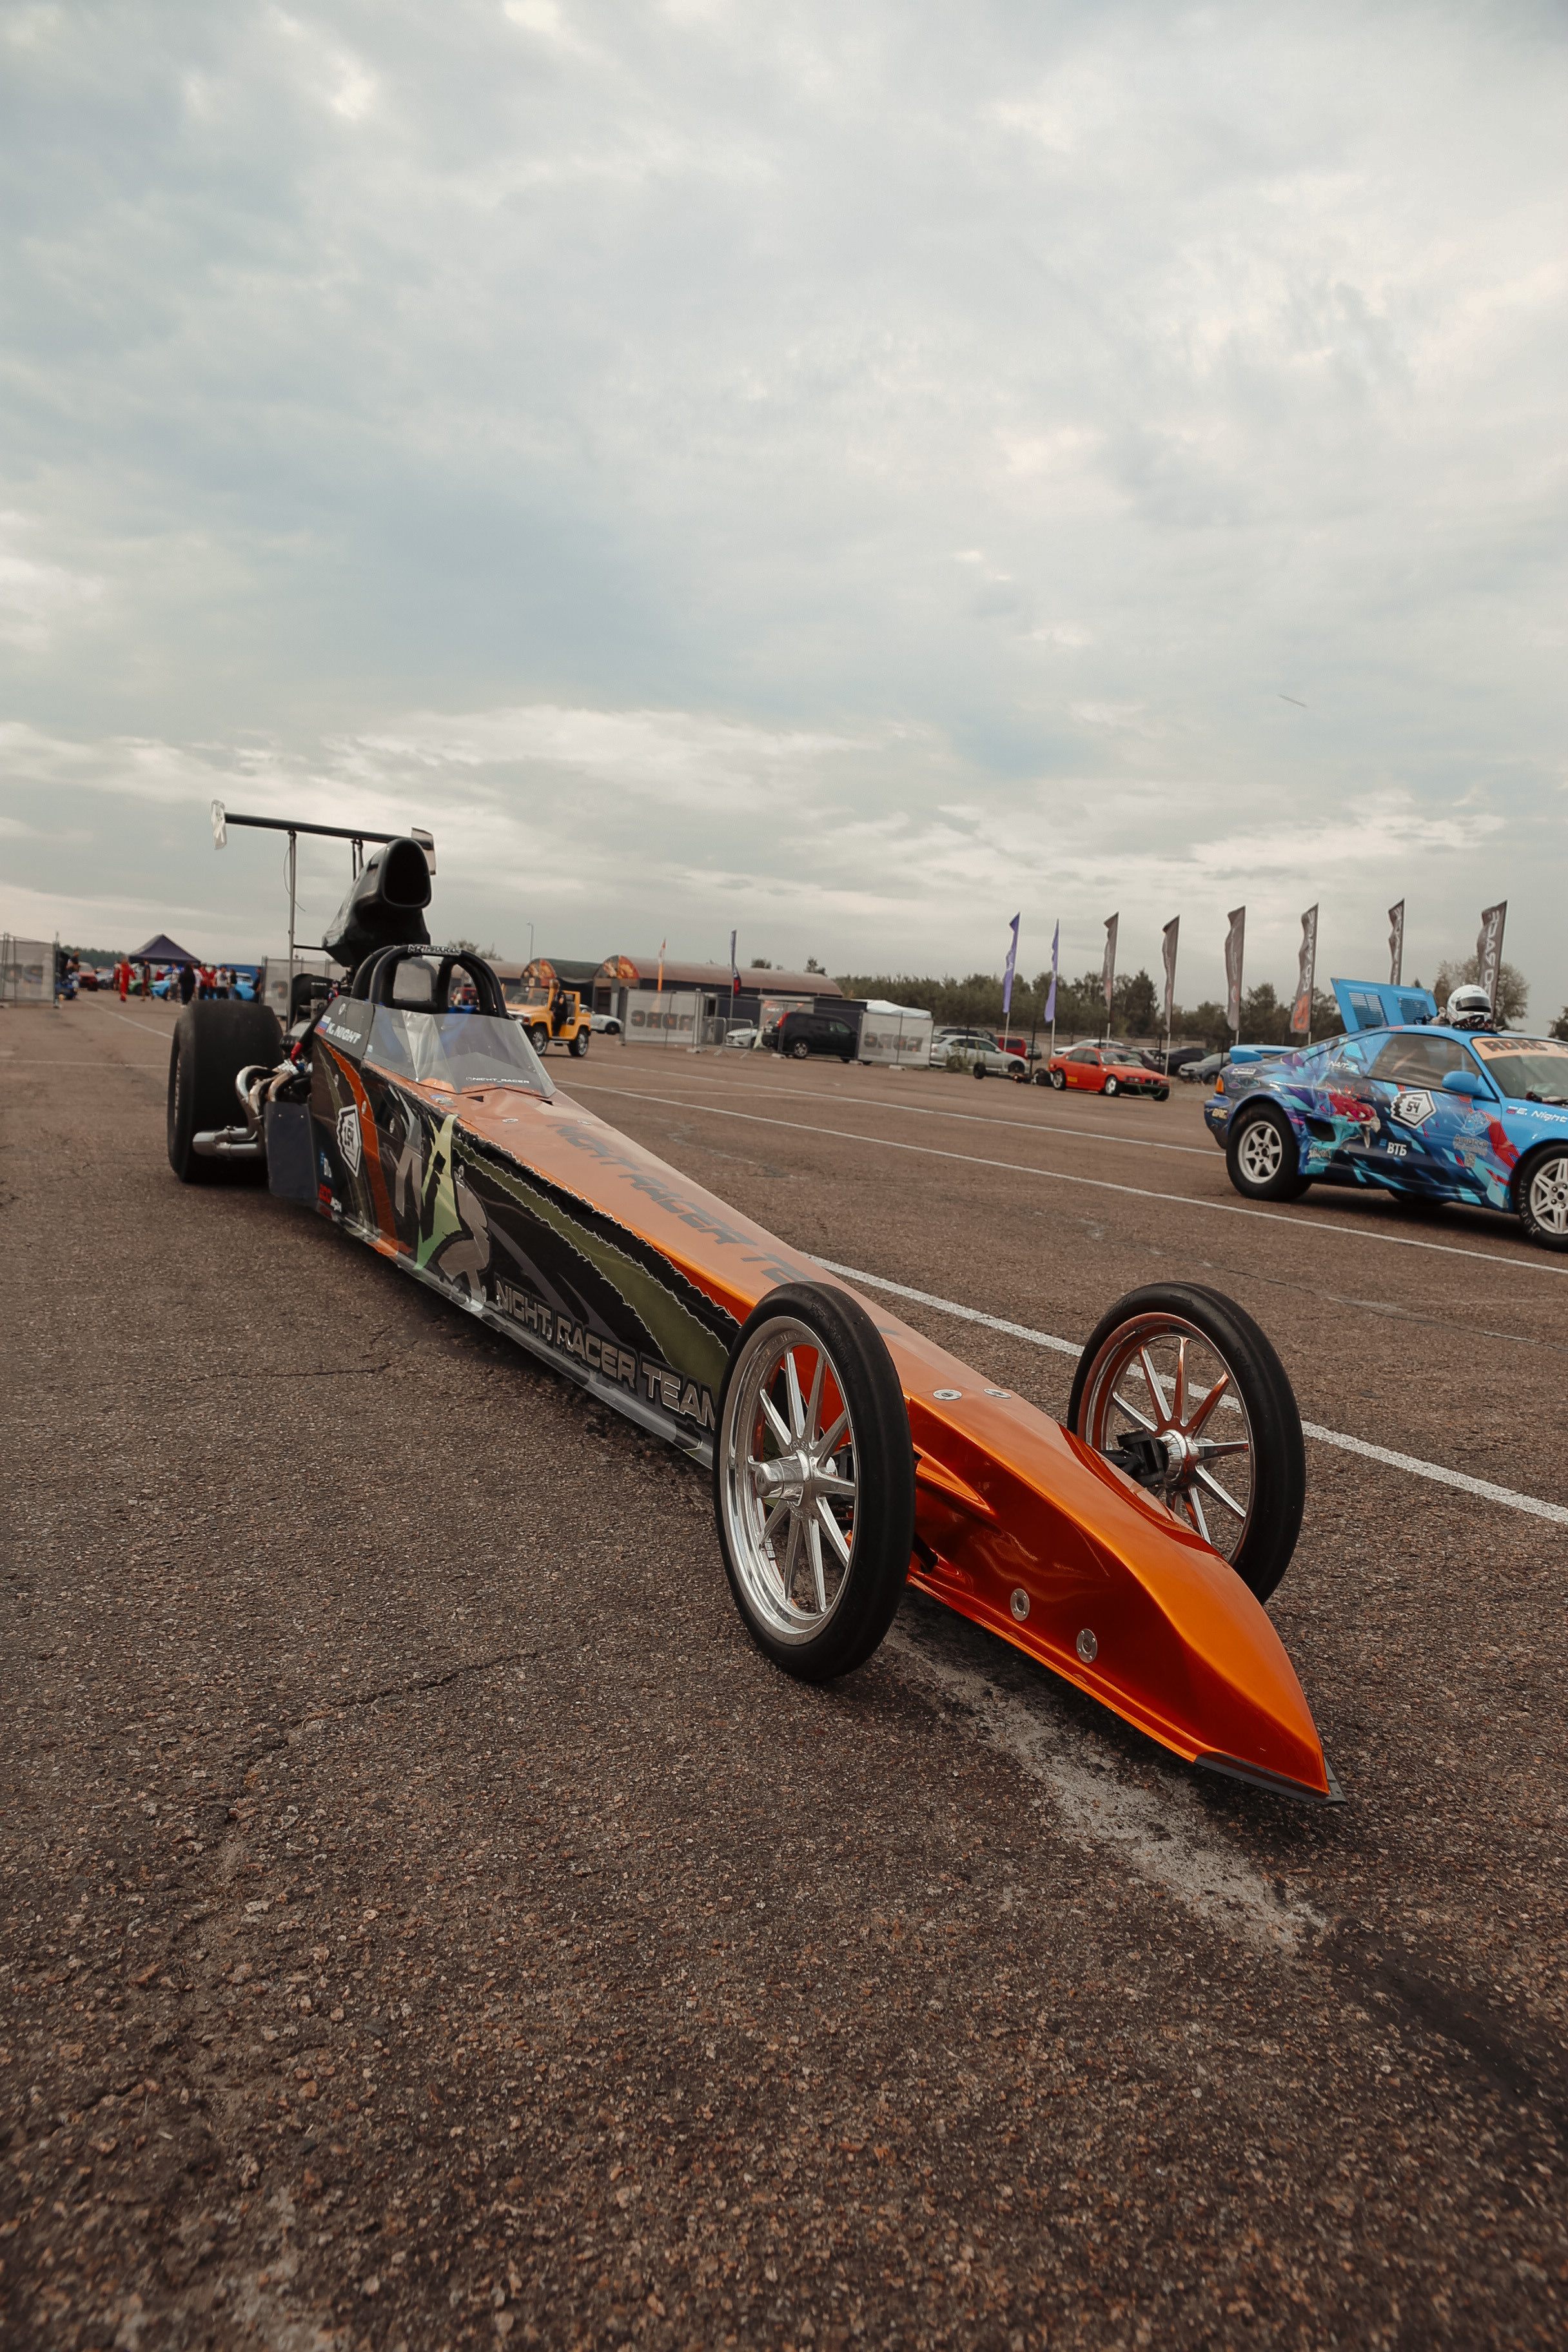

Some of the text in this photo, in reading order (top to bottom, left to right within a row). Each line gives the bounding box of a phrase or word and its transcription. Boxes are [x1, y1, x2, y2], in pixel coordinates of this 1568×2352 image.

[334, 1026, 362, 1044] NIGHT
[1406, 1101, 1420, 1113] 54
[1531, 1110, 1568, 1122] Night
[1387, 1142, 1407, 1156] ВТБ
[496, 1280, 551, 1338] NIGHT
[556, 1317, 635, 1389] RACER
